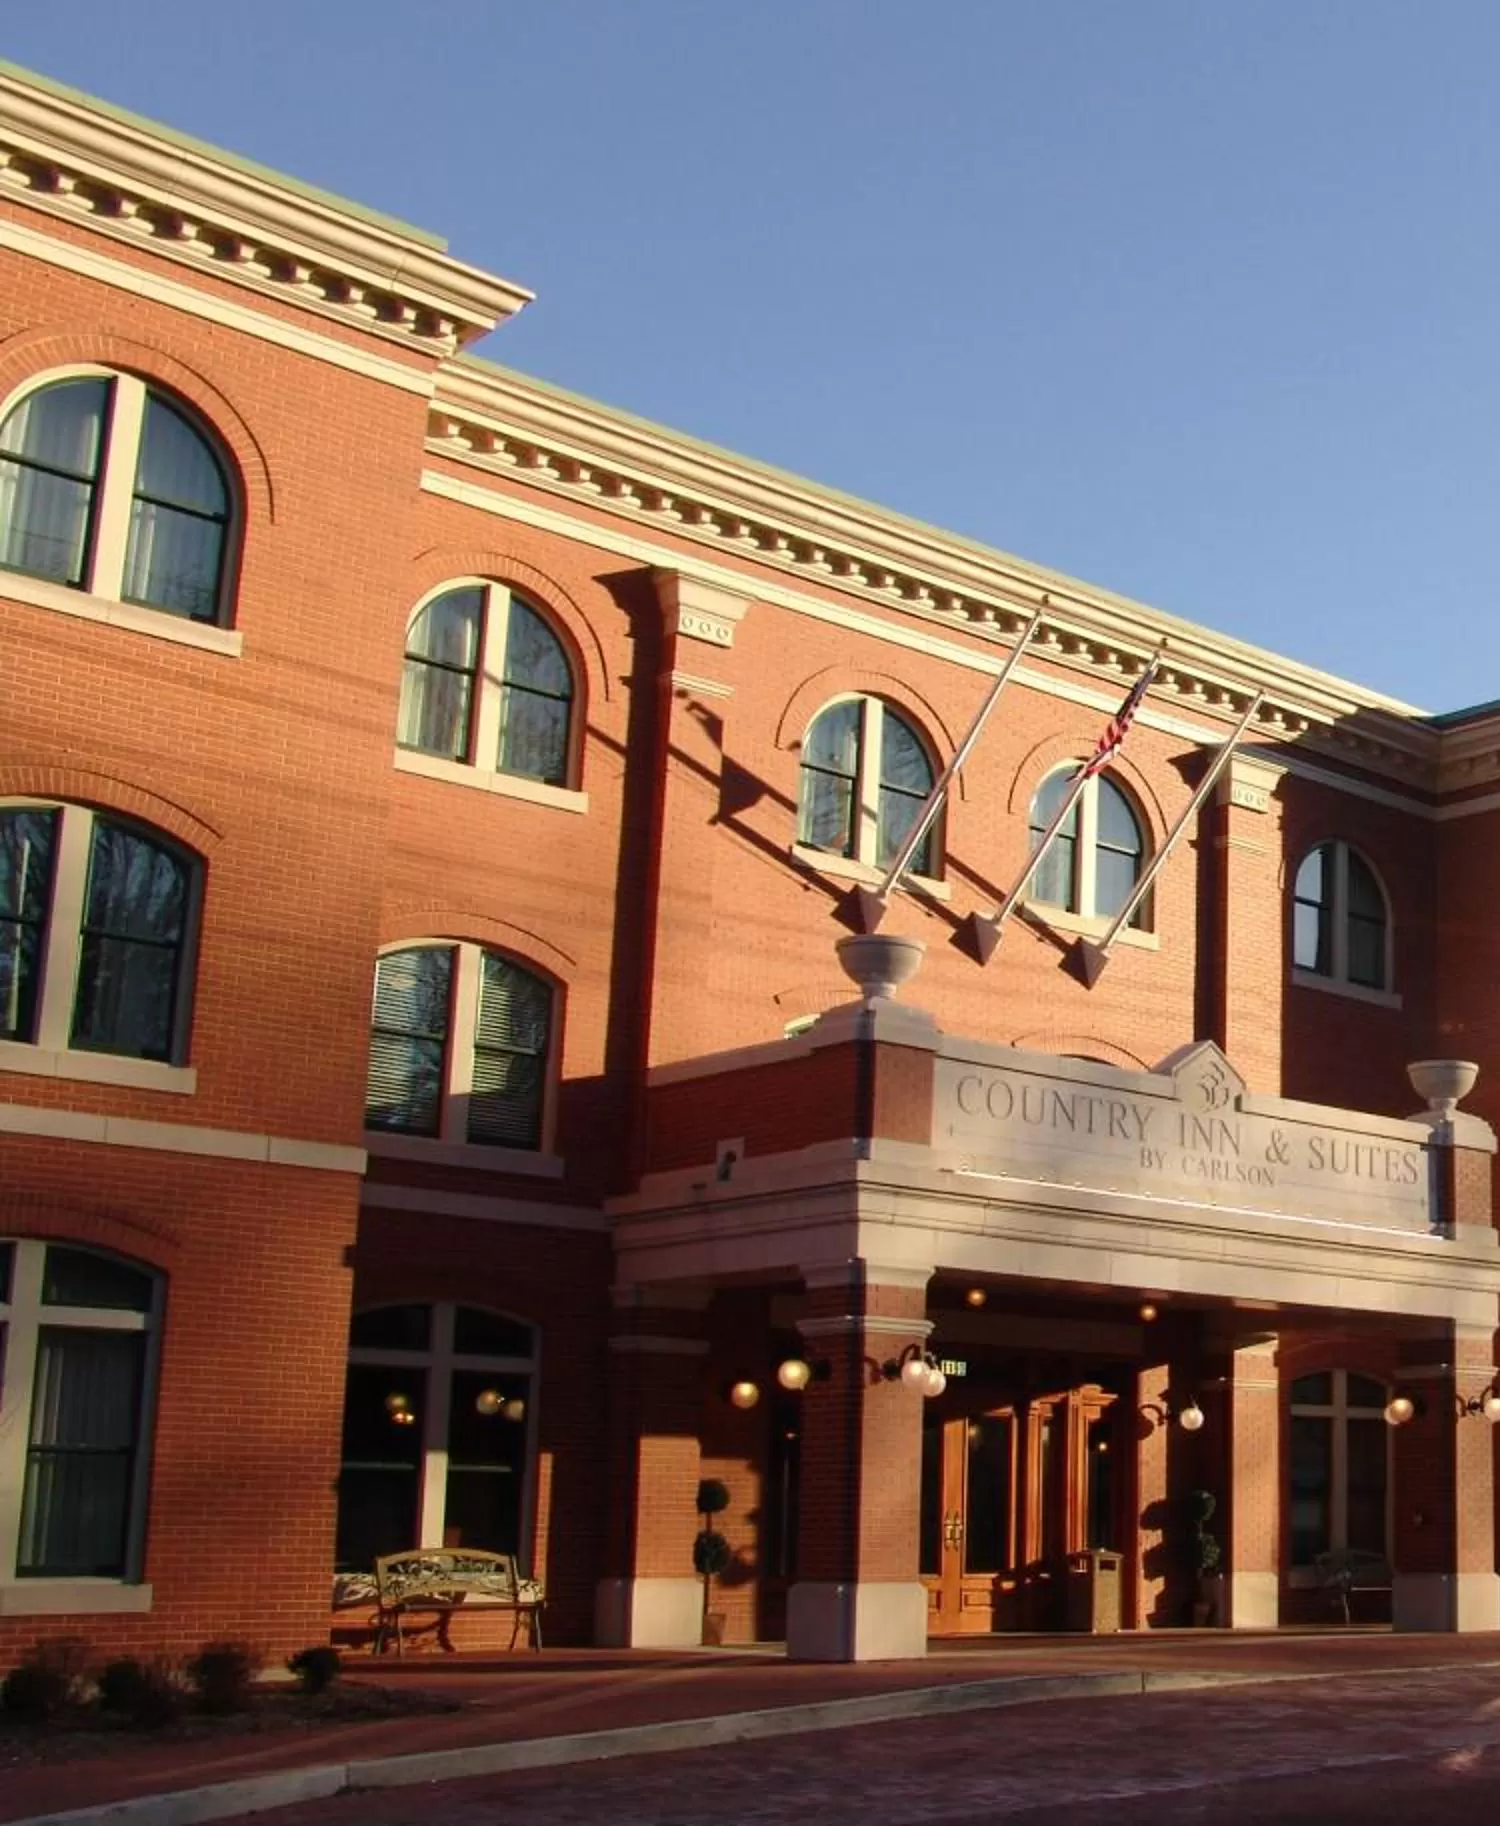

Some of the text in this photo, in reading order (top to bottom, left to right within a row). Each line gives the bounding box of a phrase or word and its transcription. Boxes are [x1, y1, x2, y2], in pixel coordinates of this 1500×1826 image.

[956, 1075, 1418, 1185] COUNTRY INN & SUITES
[1140, 1146, 1275, 1186] BY CARLSON
